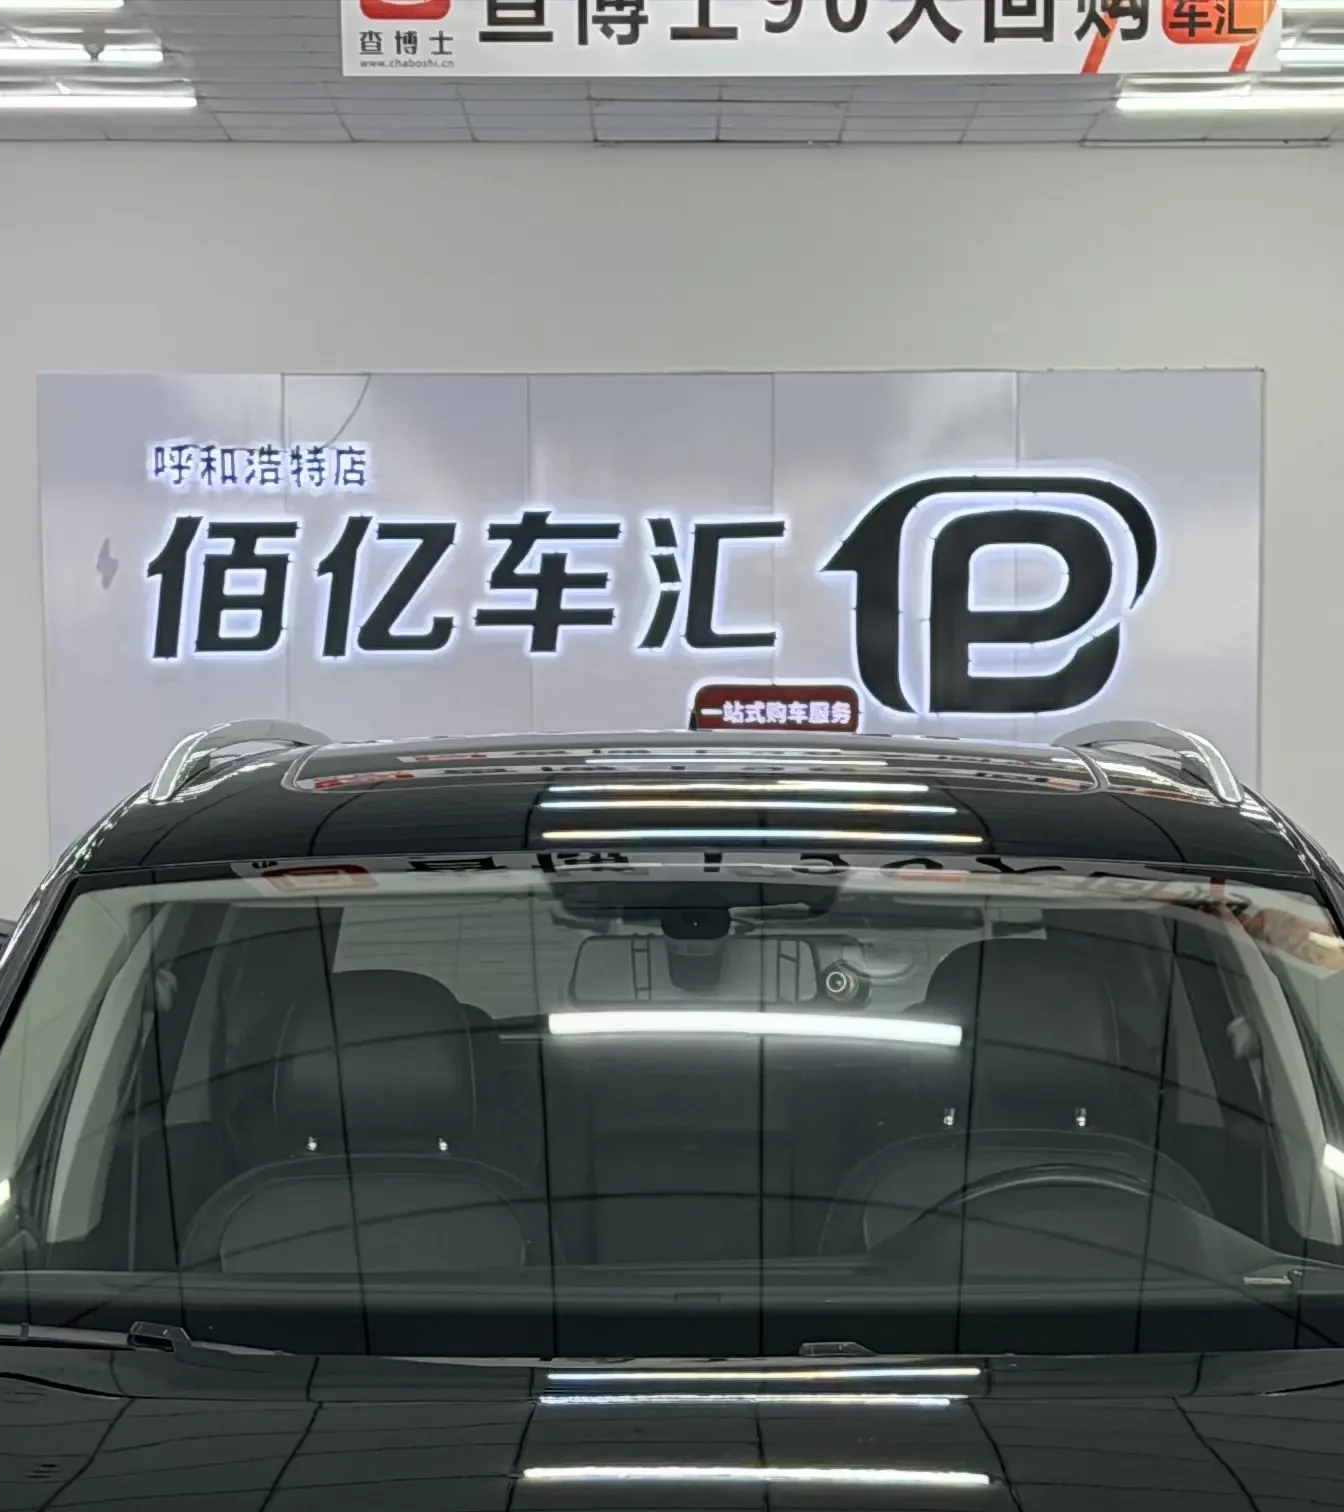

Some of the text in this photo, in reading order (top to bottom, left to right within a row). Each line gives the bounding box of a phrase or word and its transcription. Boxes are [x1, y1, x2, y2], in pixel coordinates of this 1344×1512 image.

[359, 30, 453, 55] 查博士
[360, 58, 454, 68] www.chaboshi.cn
[154, 444, 366, 487] 呼和浩特店
[147, 511, 786, 659] 佰亿车汇
[700, 700, 852, 725] 一站式购车服务
